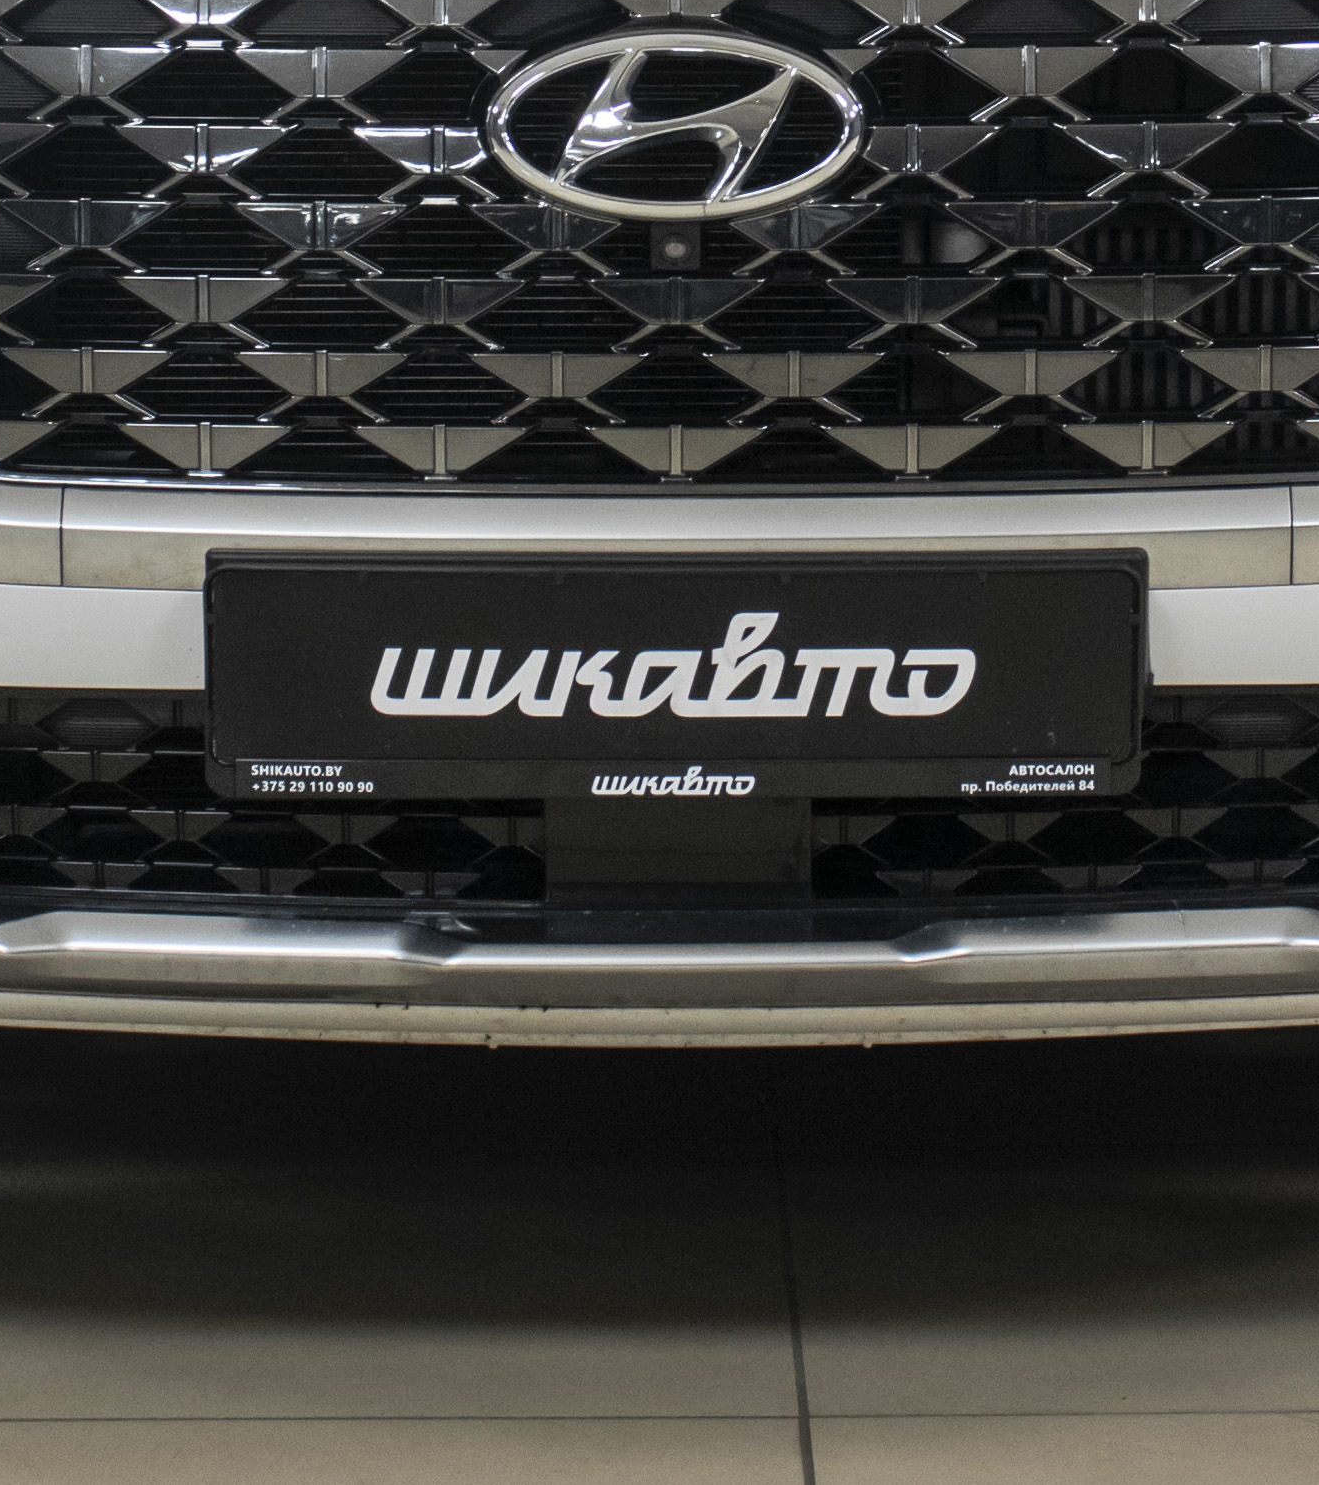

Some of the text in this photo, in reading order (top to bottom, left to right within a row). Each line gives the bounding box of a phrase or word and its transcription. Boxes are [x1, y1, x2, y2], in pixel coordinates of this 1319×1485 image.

[250, 764, 343, 777] SHIKAUTO.BY
[1008, 764, 1095, 776] АВТОСАЛОН
[251, 780, 374, 793] +375 29 110 90 90
[960, 780, 1095, 795] пр. Победителей 84
